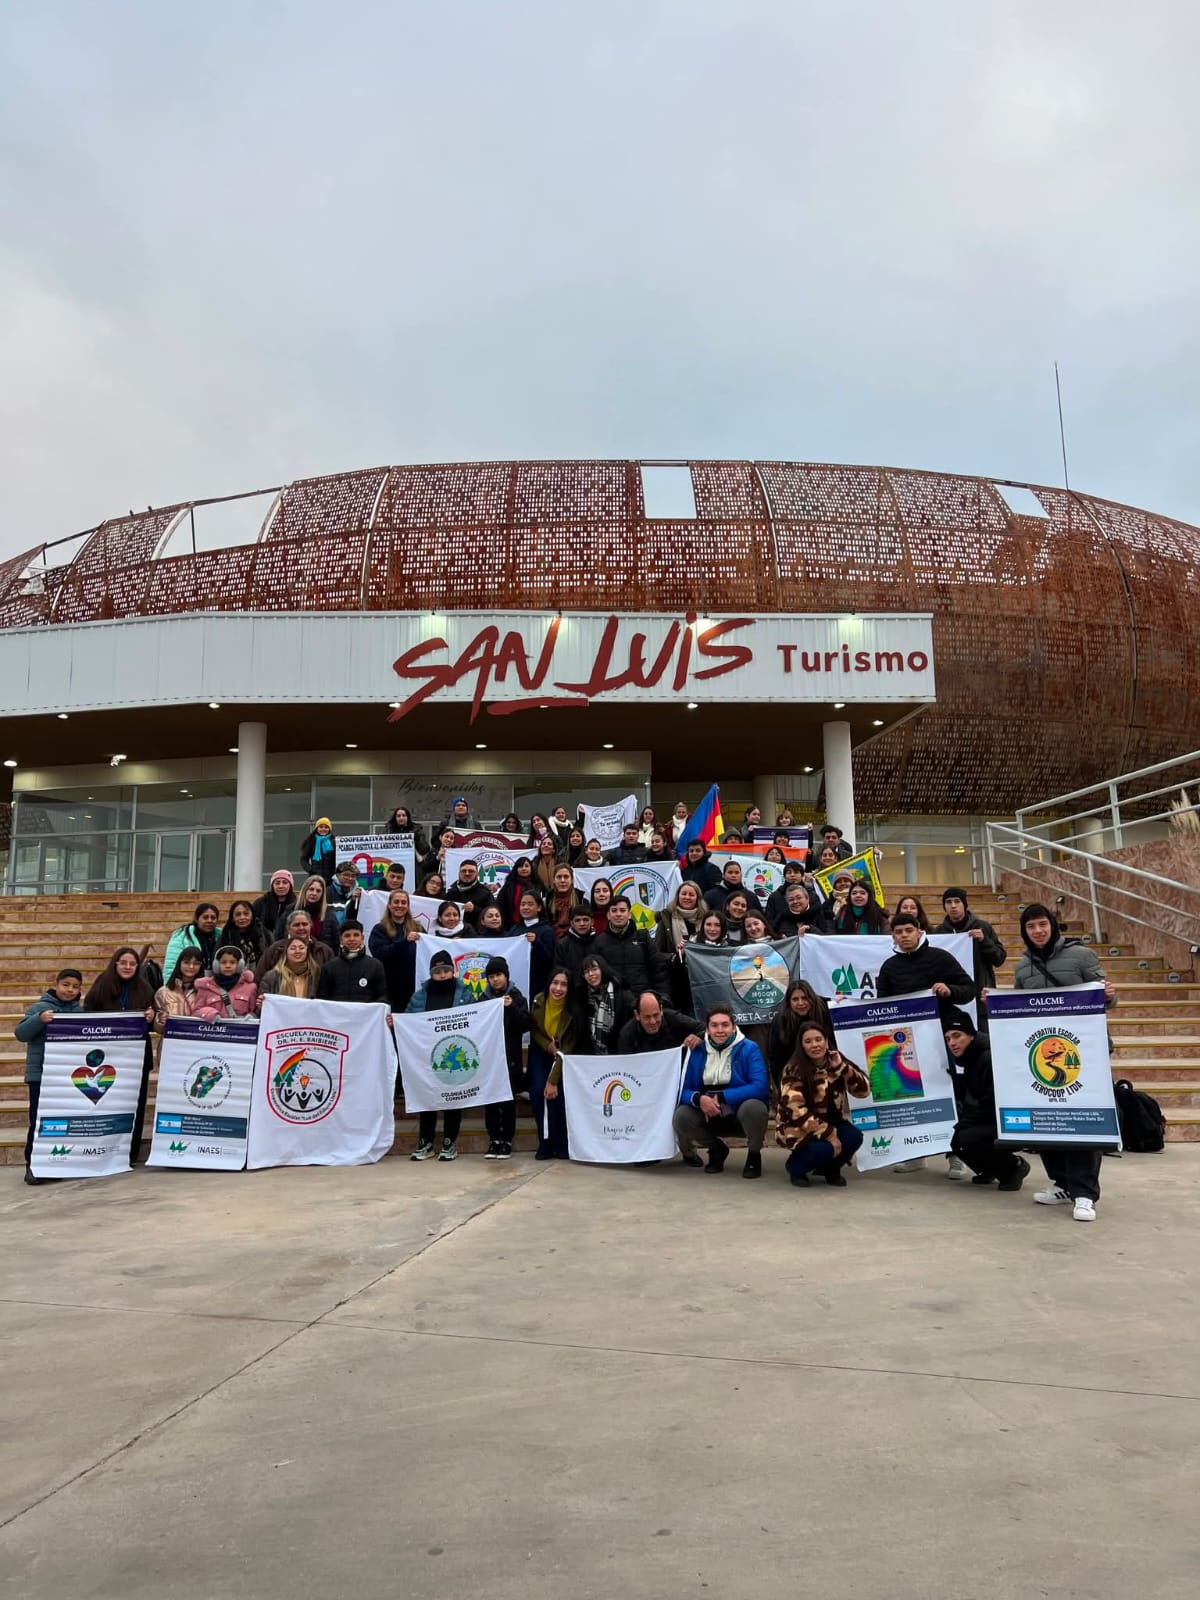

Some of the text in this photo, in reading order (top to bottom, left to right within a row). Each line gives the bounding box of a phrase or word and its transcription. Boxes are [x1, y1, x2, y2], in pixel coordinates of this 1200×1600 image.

[777, 643, 928, 673] Turismo
[387, 611, 757, 725] SAN LUIS
[399, 778, 485, 794] Bienvenidos
[339, 835, 384, 843] COOPERATIVA
[1029, 997, 1064, 1005] CALCME
[452, 1010, 478, 1018] EDUCATIVO
[866, 1007, 899, 1016] CALCME
[198, 1025, 227, 1033] CALCME
[434, 1021, 470, 1032] CRECER
[276, 1031, 338, 1041] ESCUELA NORMAL
[1025, 1027, 1081, 1048] COOPERATIVA ESCOLAR
[593, 1071, 622, 1088] COOPERATIVA
[441, 1090, 462, 1098] COLONIA
[1031, 1080, 1083, 1098] AEROCOOP LTDA
[903, 1135, 929, 1145] INAES
[82, 1147, 105, 1155] INAES
[198, 1146, 220, 1154] INAES
